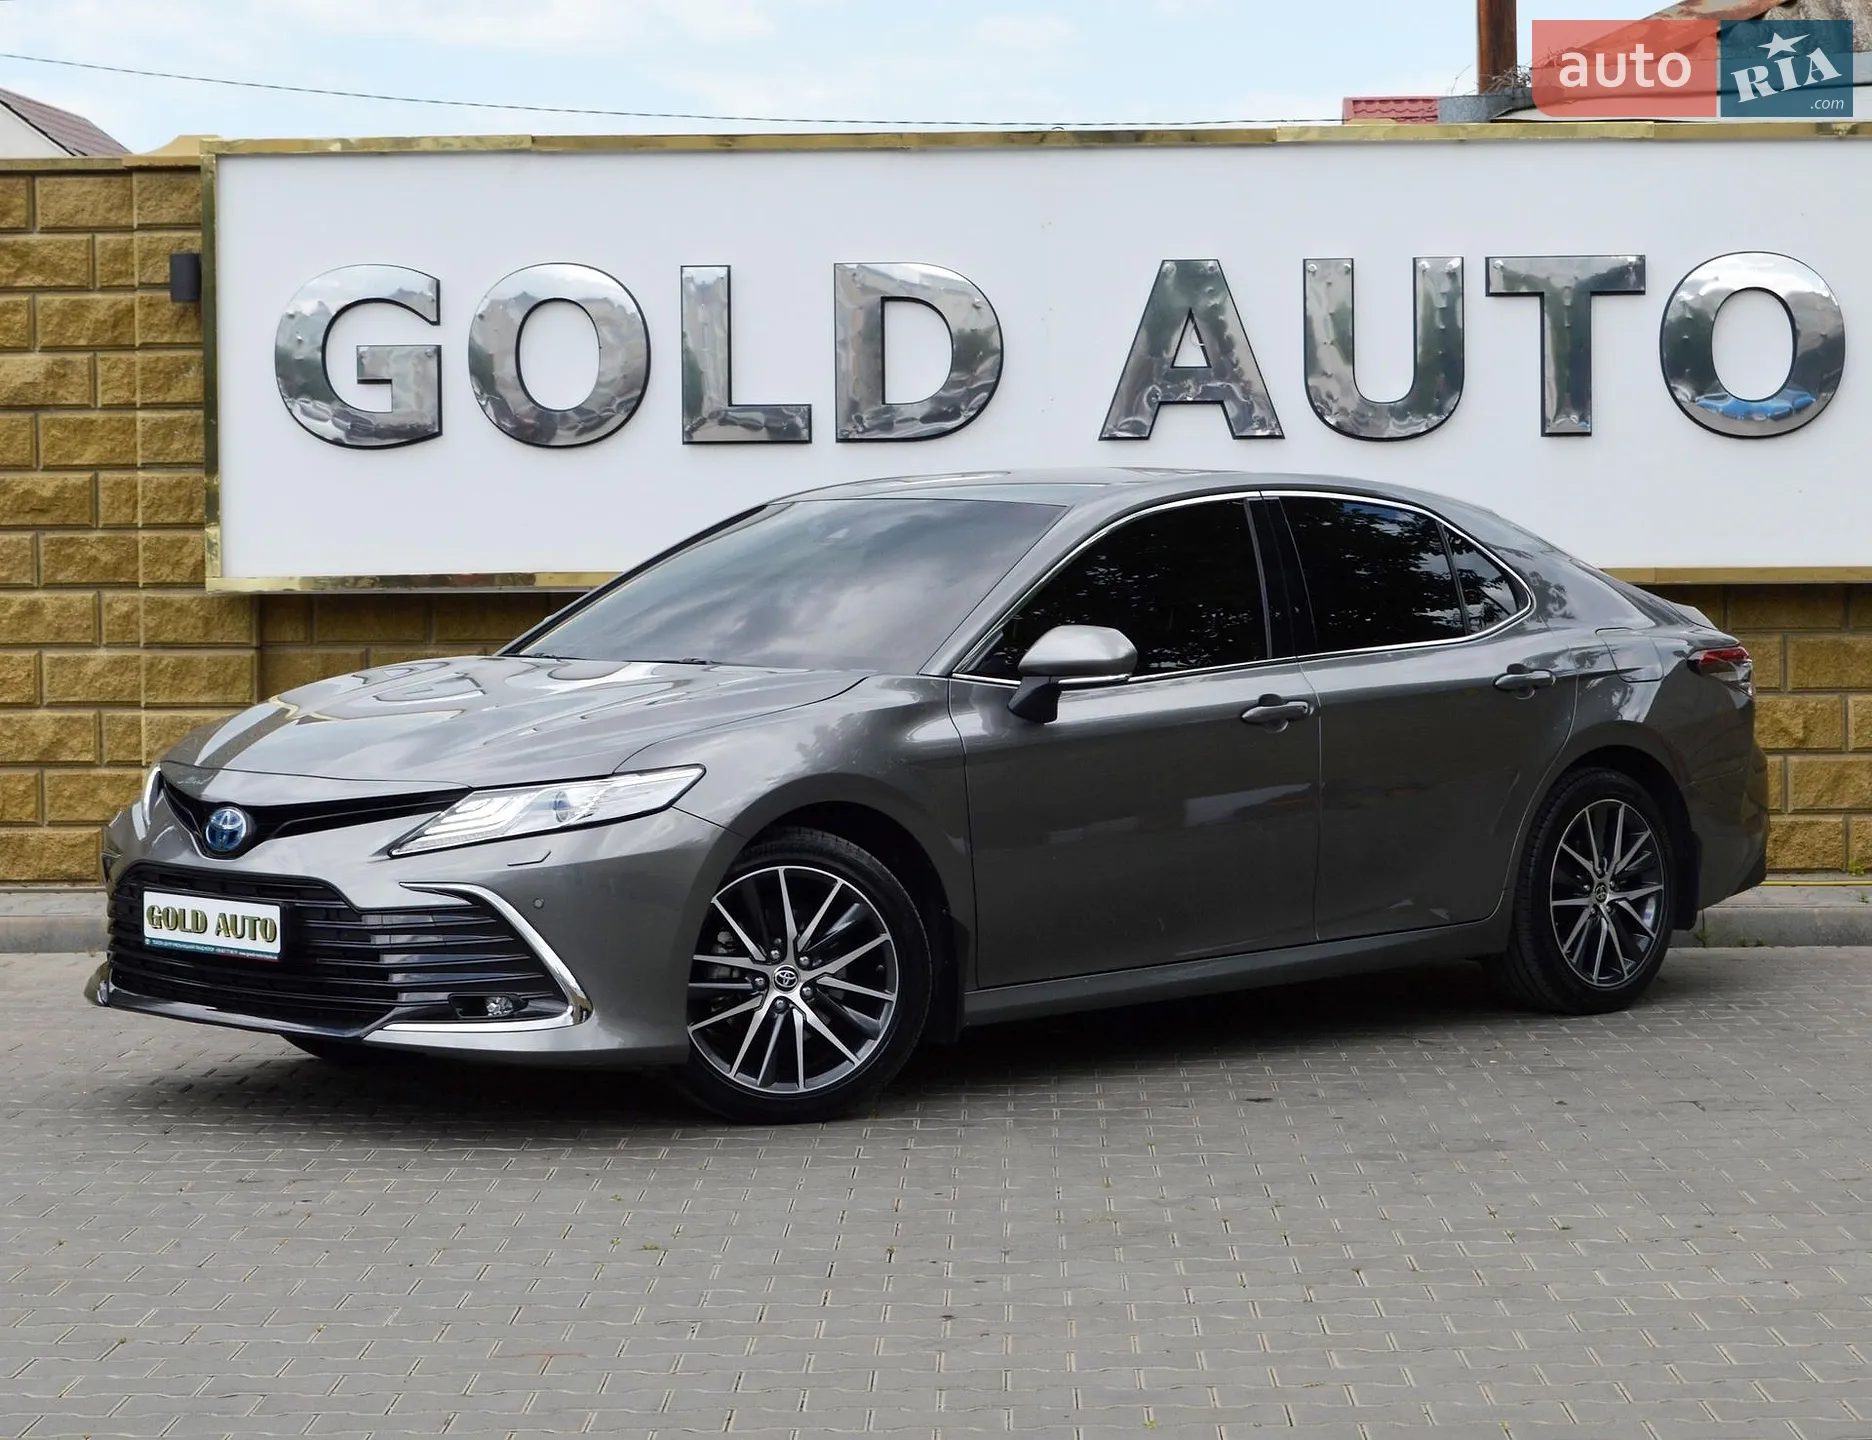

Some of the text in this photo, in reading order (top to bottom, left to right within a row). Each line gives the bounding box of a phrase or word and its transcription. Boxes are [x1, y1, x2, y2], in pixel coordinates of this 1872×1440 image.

[274, 251, 1847, 450] GOLD AUTO
[146, 905, 277, 943] GOLD AUTO
